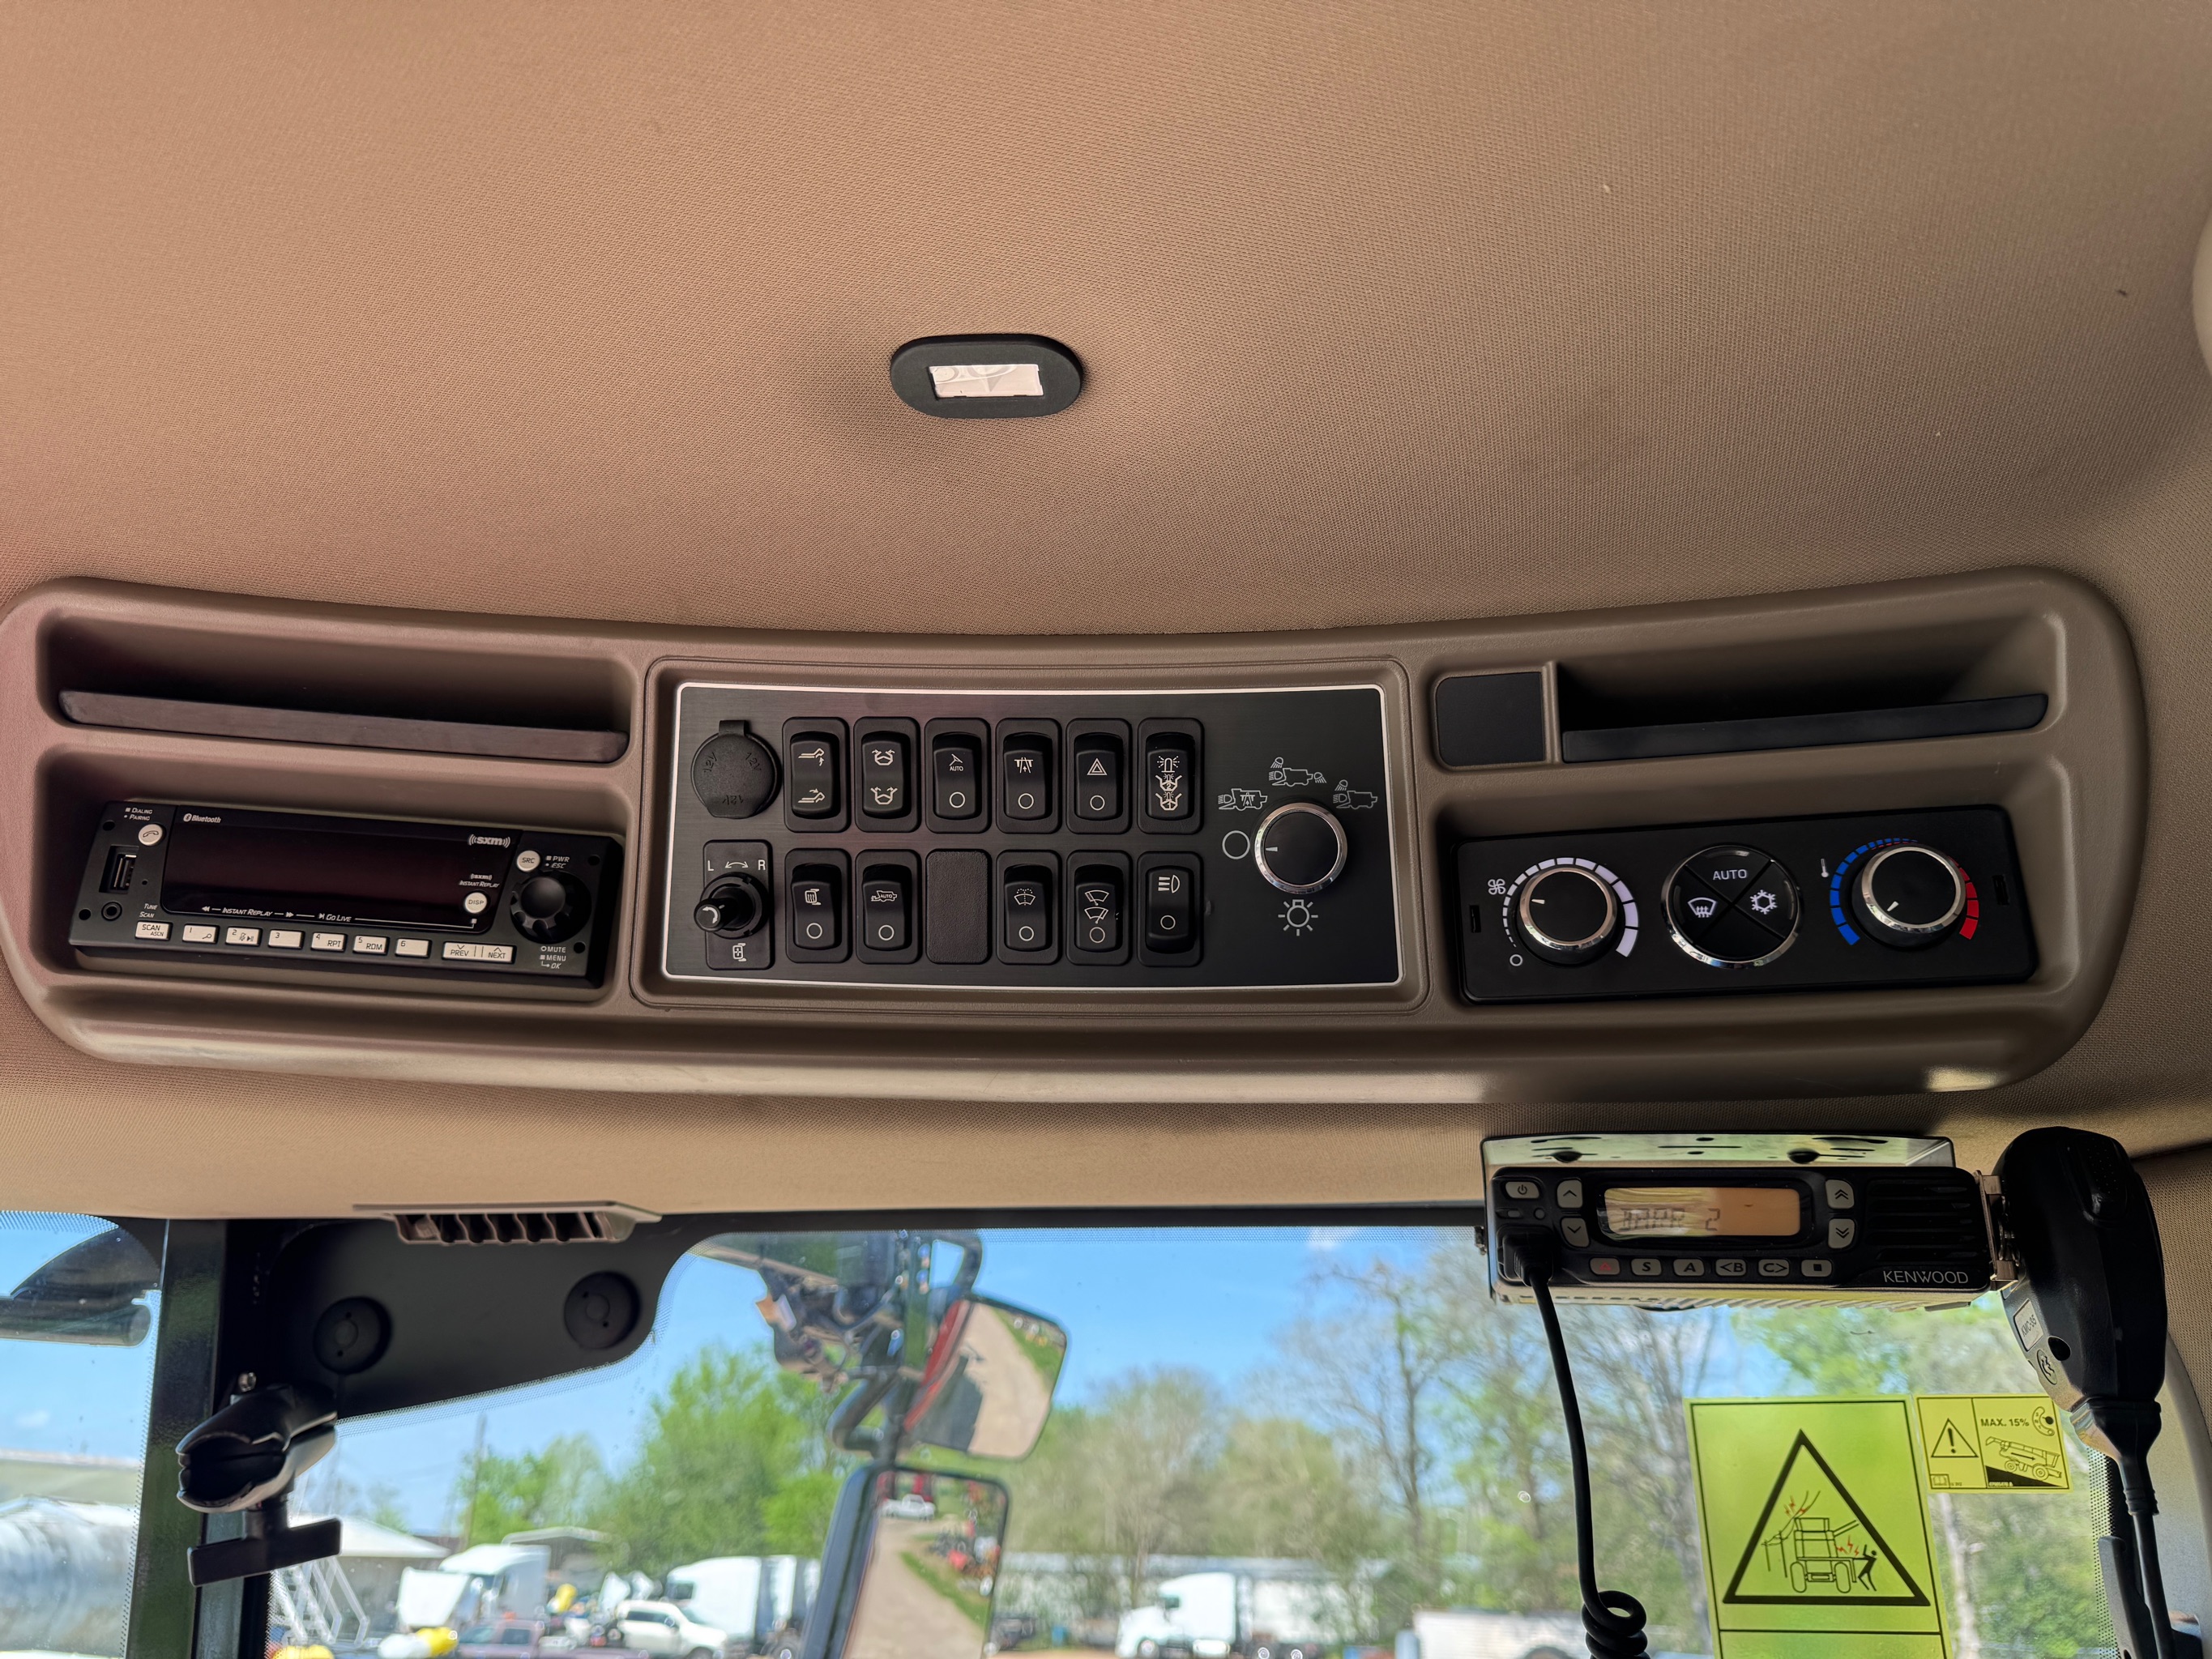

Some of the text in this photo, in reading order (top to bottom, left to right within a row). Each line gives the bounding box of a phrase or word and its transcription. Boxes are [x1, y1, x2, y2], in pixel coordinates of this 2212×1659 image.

[191, 815, 221, 823] Bluetooth
[707, 859, 766, 872] L R
[1712, 869, 1748, 881] AUTO
[247, 909, 273, 917] REPLAY
[327, 940, 341, 948] RPT
[1706, 1208, 1720, 1231] 2
[1642, 1262, 1651, 1272] S
[1684, 1262, 1697, 1273] A
[1883, 1270, 1969, 1284] KENWOOD
[1980, 1418, 2007, 1427] MAX.
[2009, 1418, 2030, 1427] 15%
